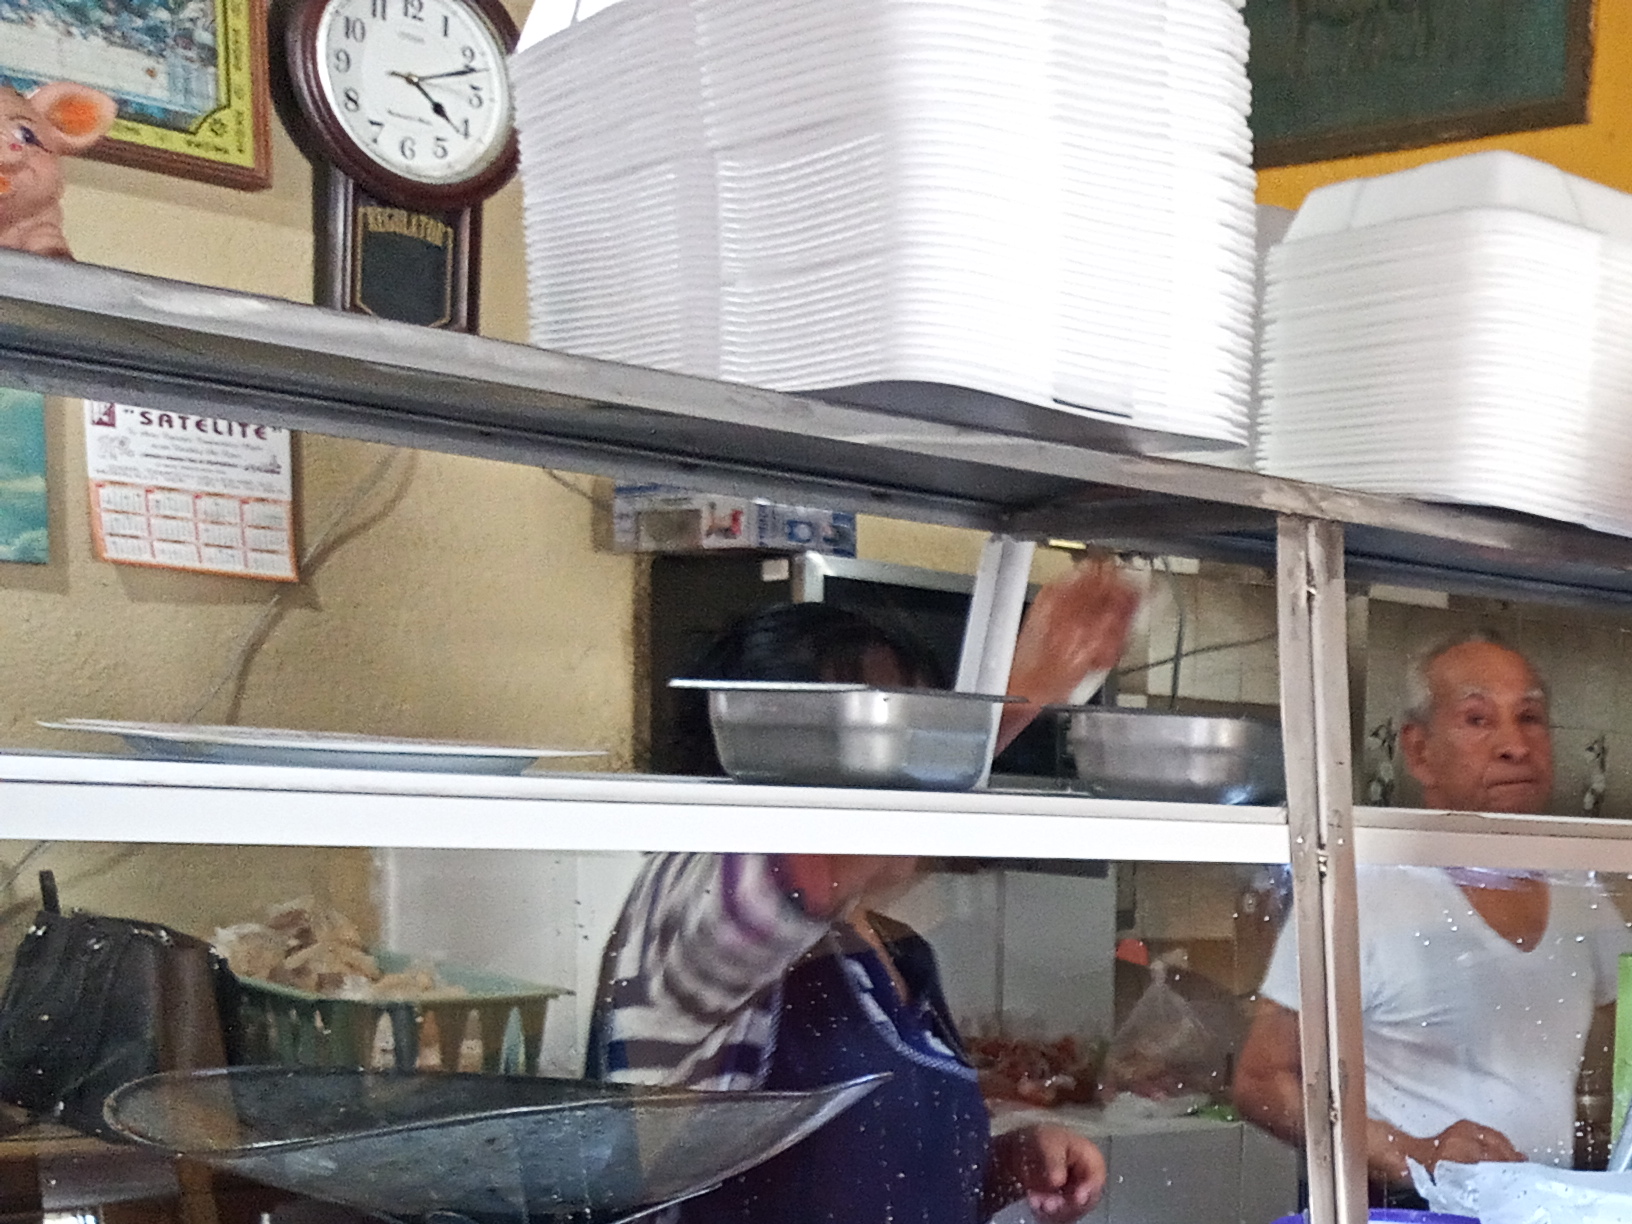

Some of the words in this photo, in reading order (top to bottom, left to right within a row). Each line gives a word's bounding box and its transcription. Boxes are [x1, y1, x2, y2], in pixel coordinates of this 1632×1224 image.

[344, 16, 366, 42] 10
[442, 15, 450, 37] 1
[335, 48, 352, 73] 9
[343, 87, 360, 113] 8
[368, 118, 385, 144] 7
[400, 136, 417, 160] 6
[433, 136, 448, 159] 5
